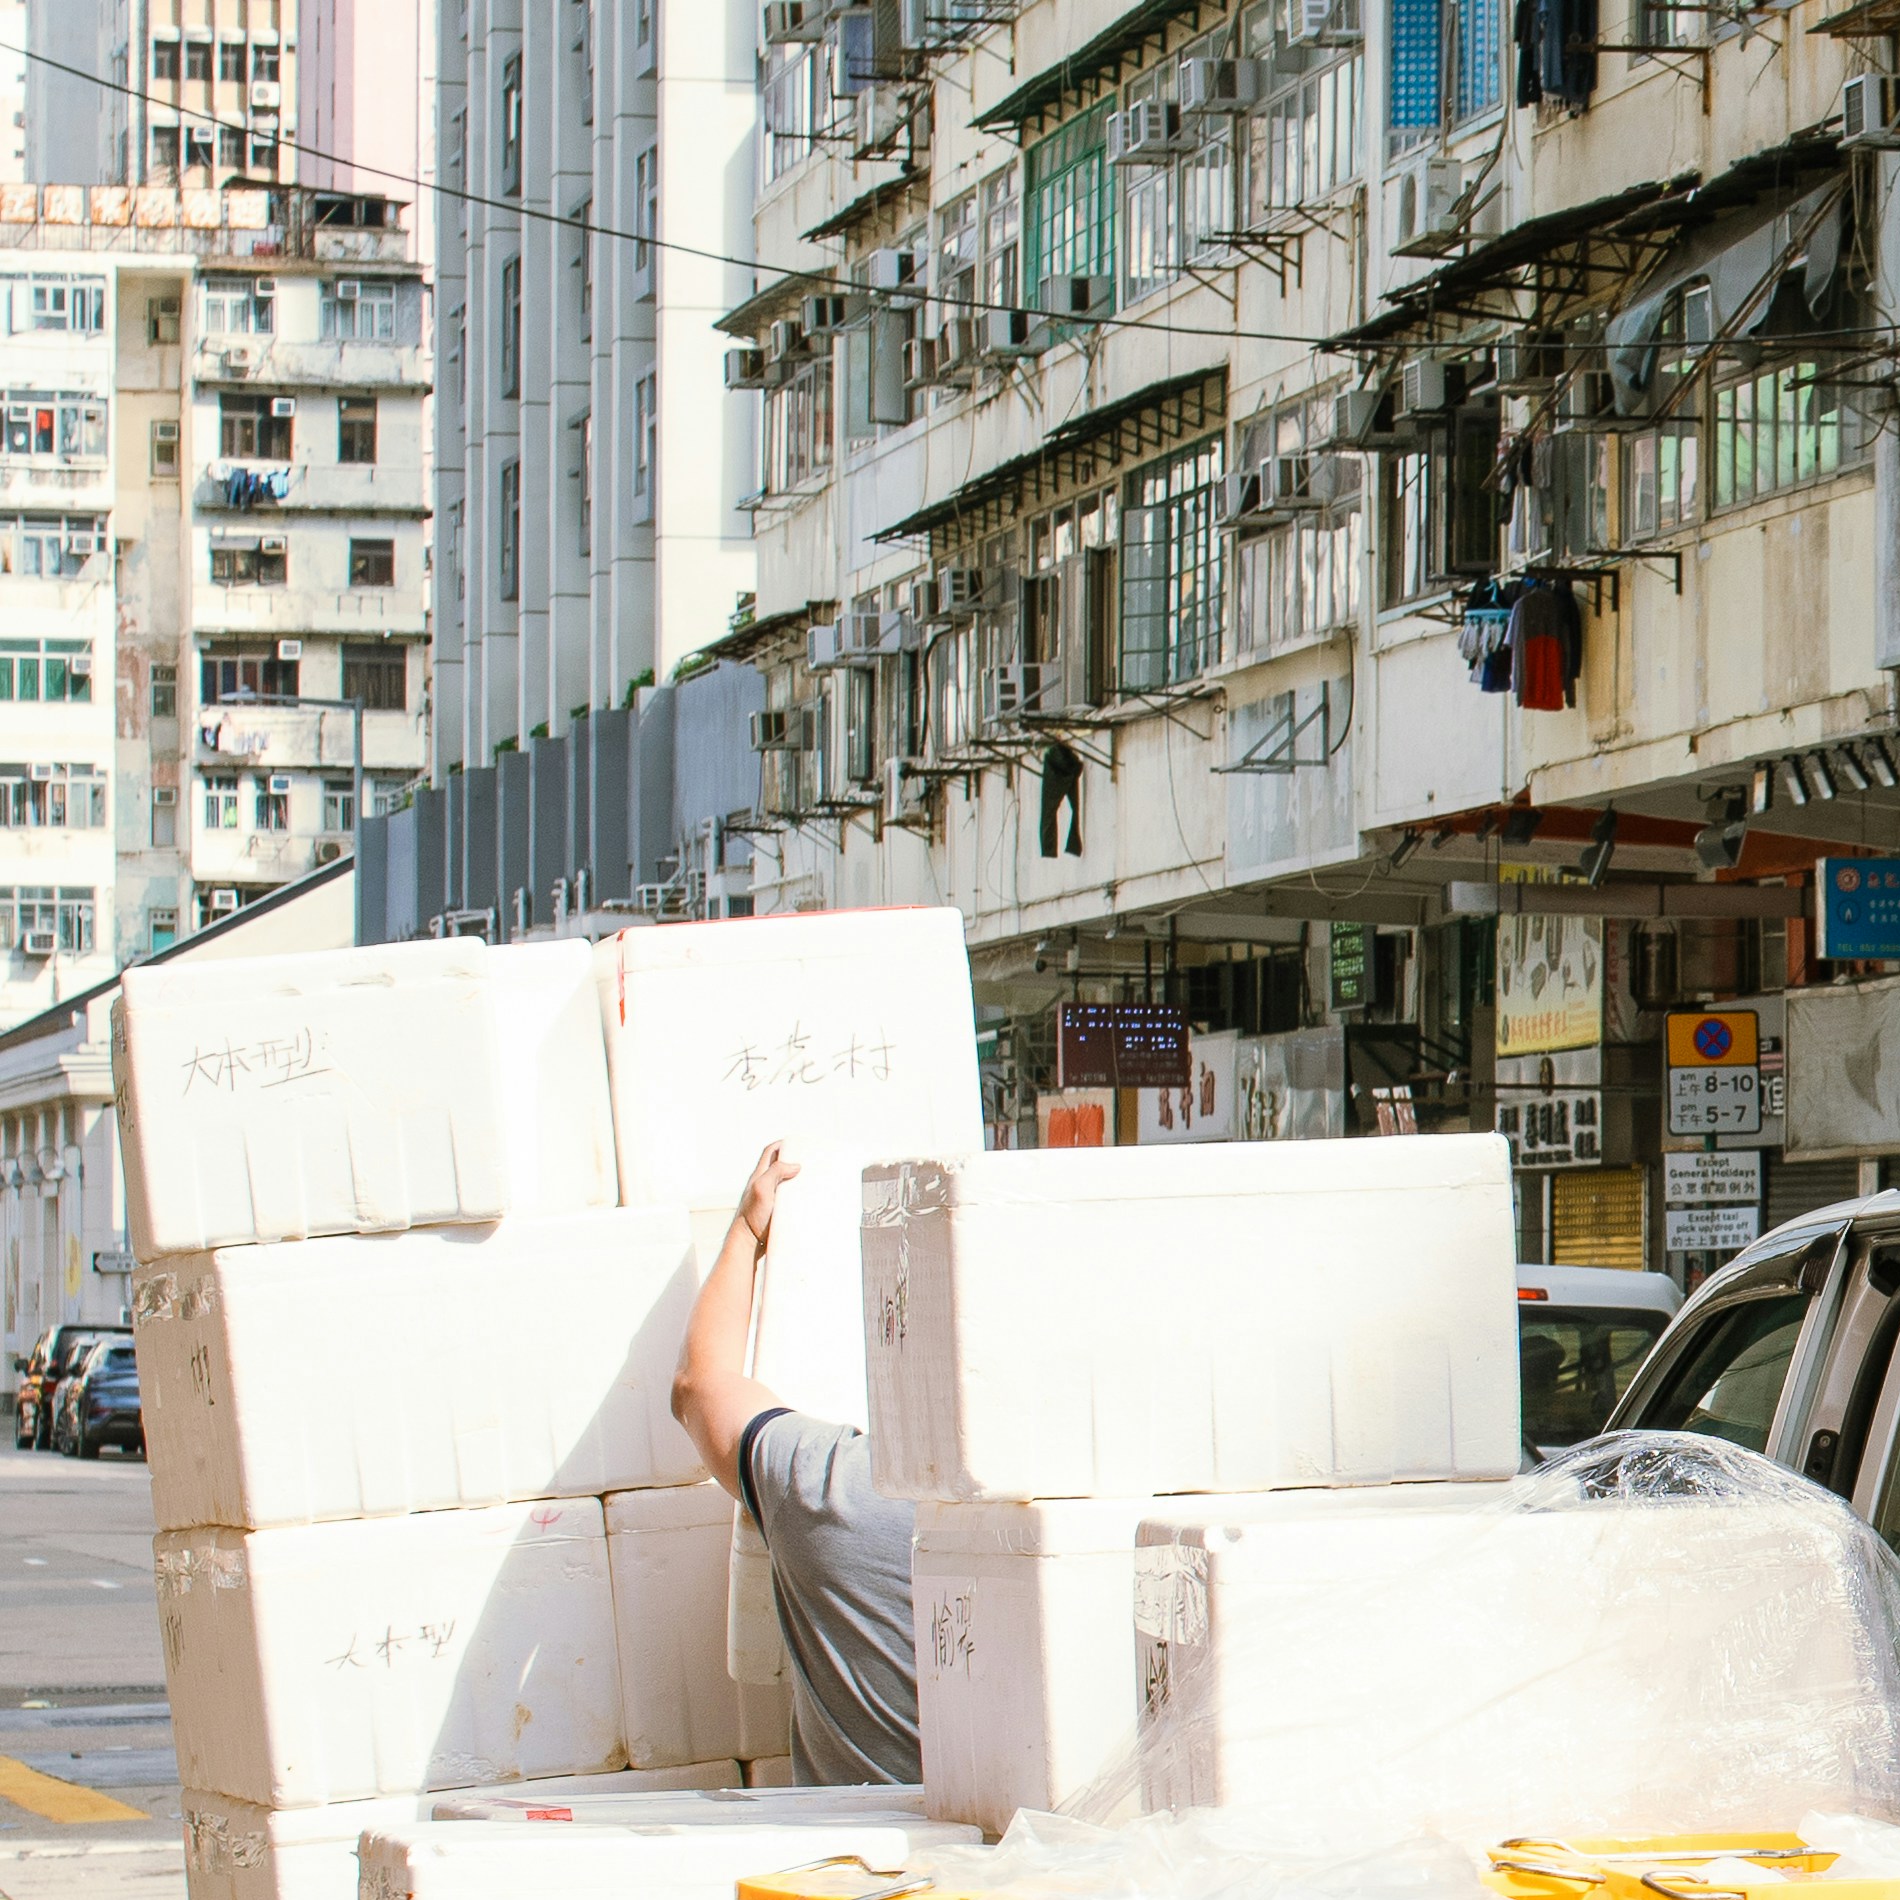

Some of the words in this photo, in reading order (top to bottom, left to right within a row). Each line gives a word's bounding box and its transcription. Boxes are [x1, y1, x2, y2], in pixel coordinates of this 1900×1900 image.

[1680, 1073, 1697, 1081] am
[1705, 1074, 1754, 1093] 8-10
[1675, 1083, 1701, 1097] 上午
[1680, 1104, 1697, 1112] pm
[1676, 1115, 1702, 1128] 下午
[1696, 1158, 1730, 1169] Except
[1669, 1169, 1709, 1178] General
[1712, 1168, 1756, 1180] Holidays
[1688, 1213, 1721, 1225] Except
[1723, 1211, 1739, 1221] taxi
[1676, 1224, 1696, 1234] pick
[1737, 1221, 1749, 1230] off
